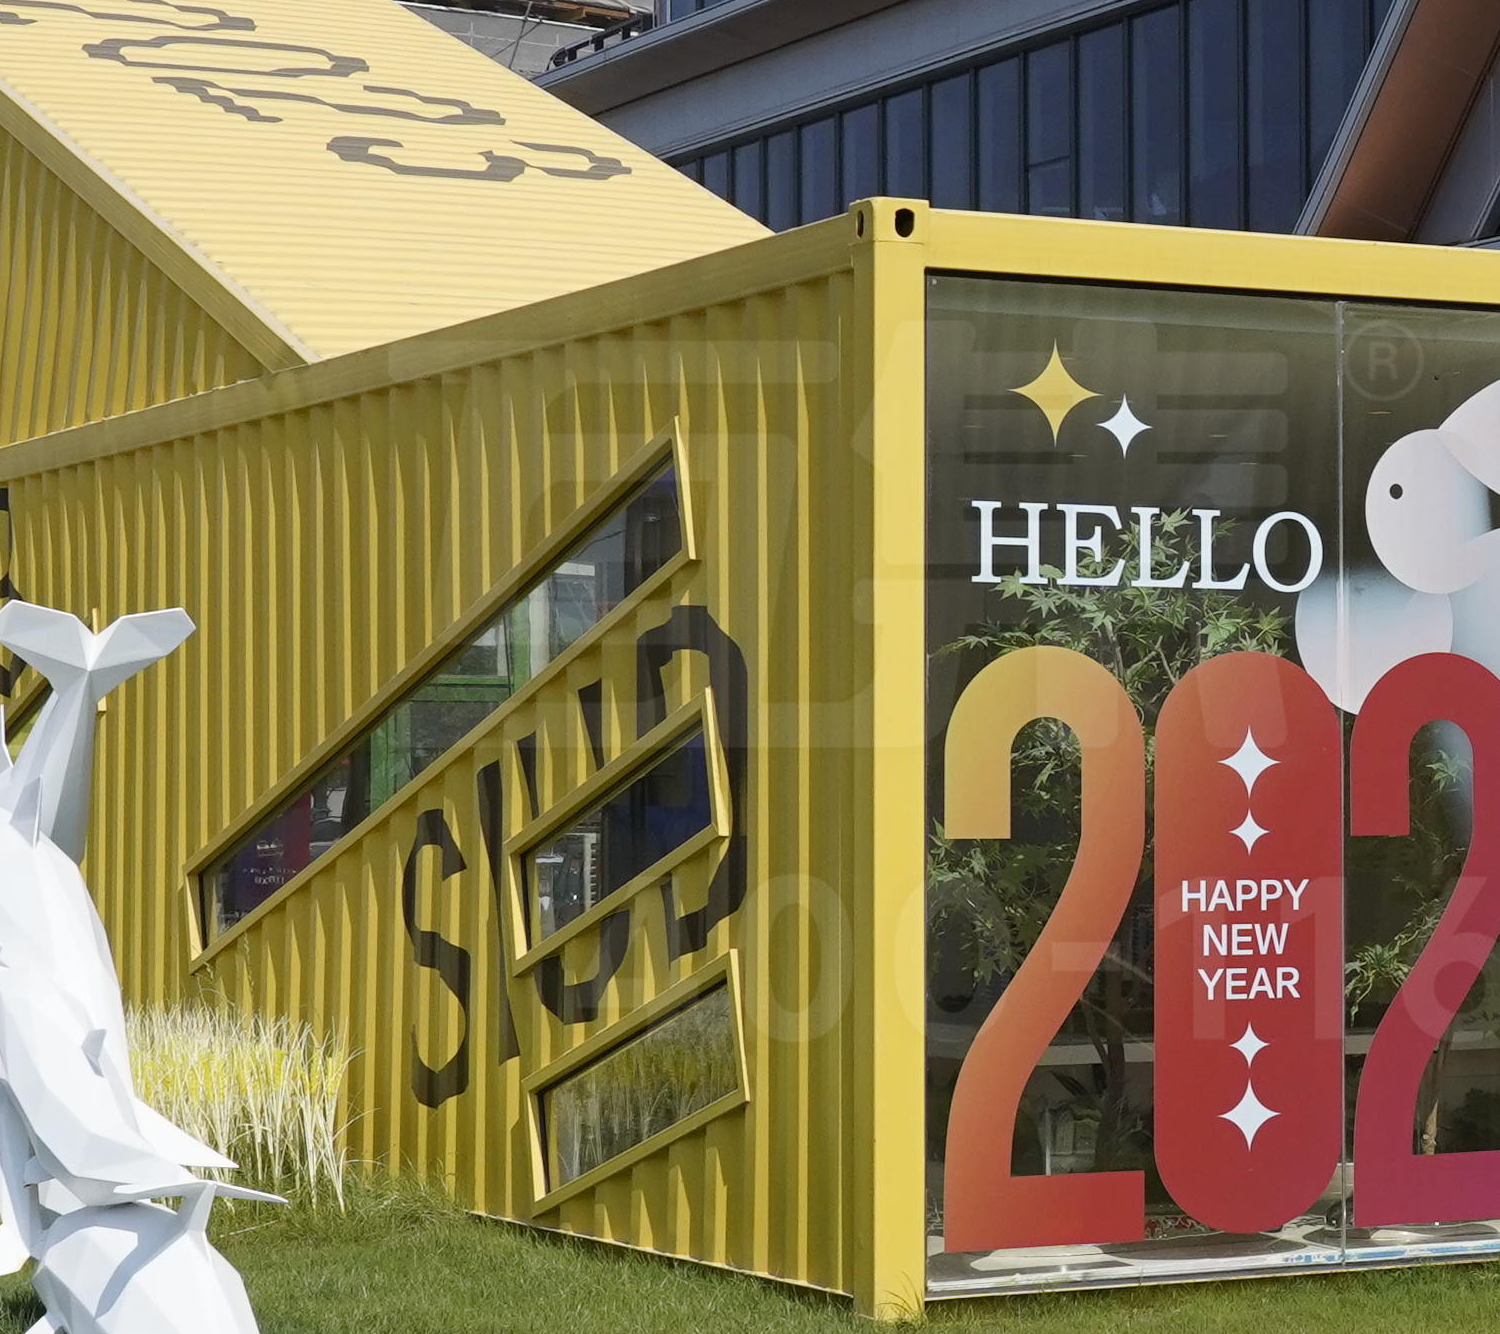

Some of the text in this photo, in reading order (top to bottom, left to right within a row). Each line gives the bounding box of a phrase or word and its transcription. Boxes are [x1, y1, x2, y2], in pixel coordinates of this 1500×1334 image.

[971, 500, 1324, 594] HELLO
[1181, 878, 1310, 913] HAPPY
[1202, 922, 1290, 957] NEW
[1197, 967, 1301, 1001] YEAR
